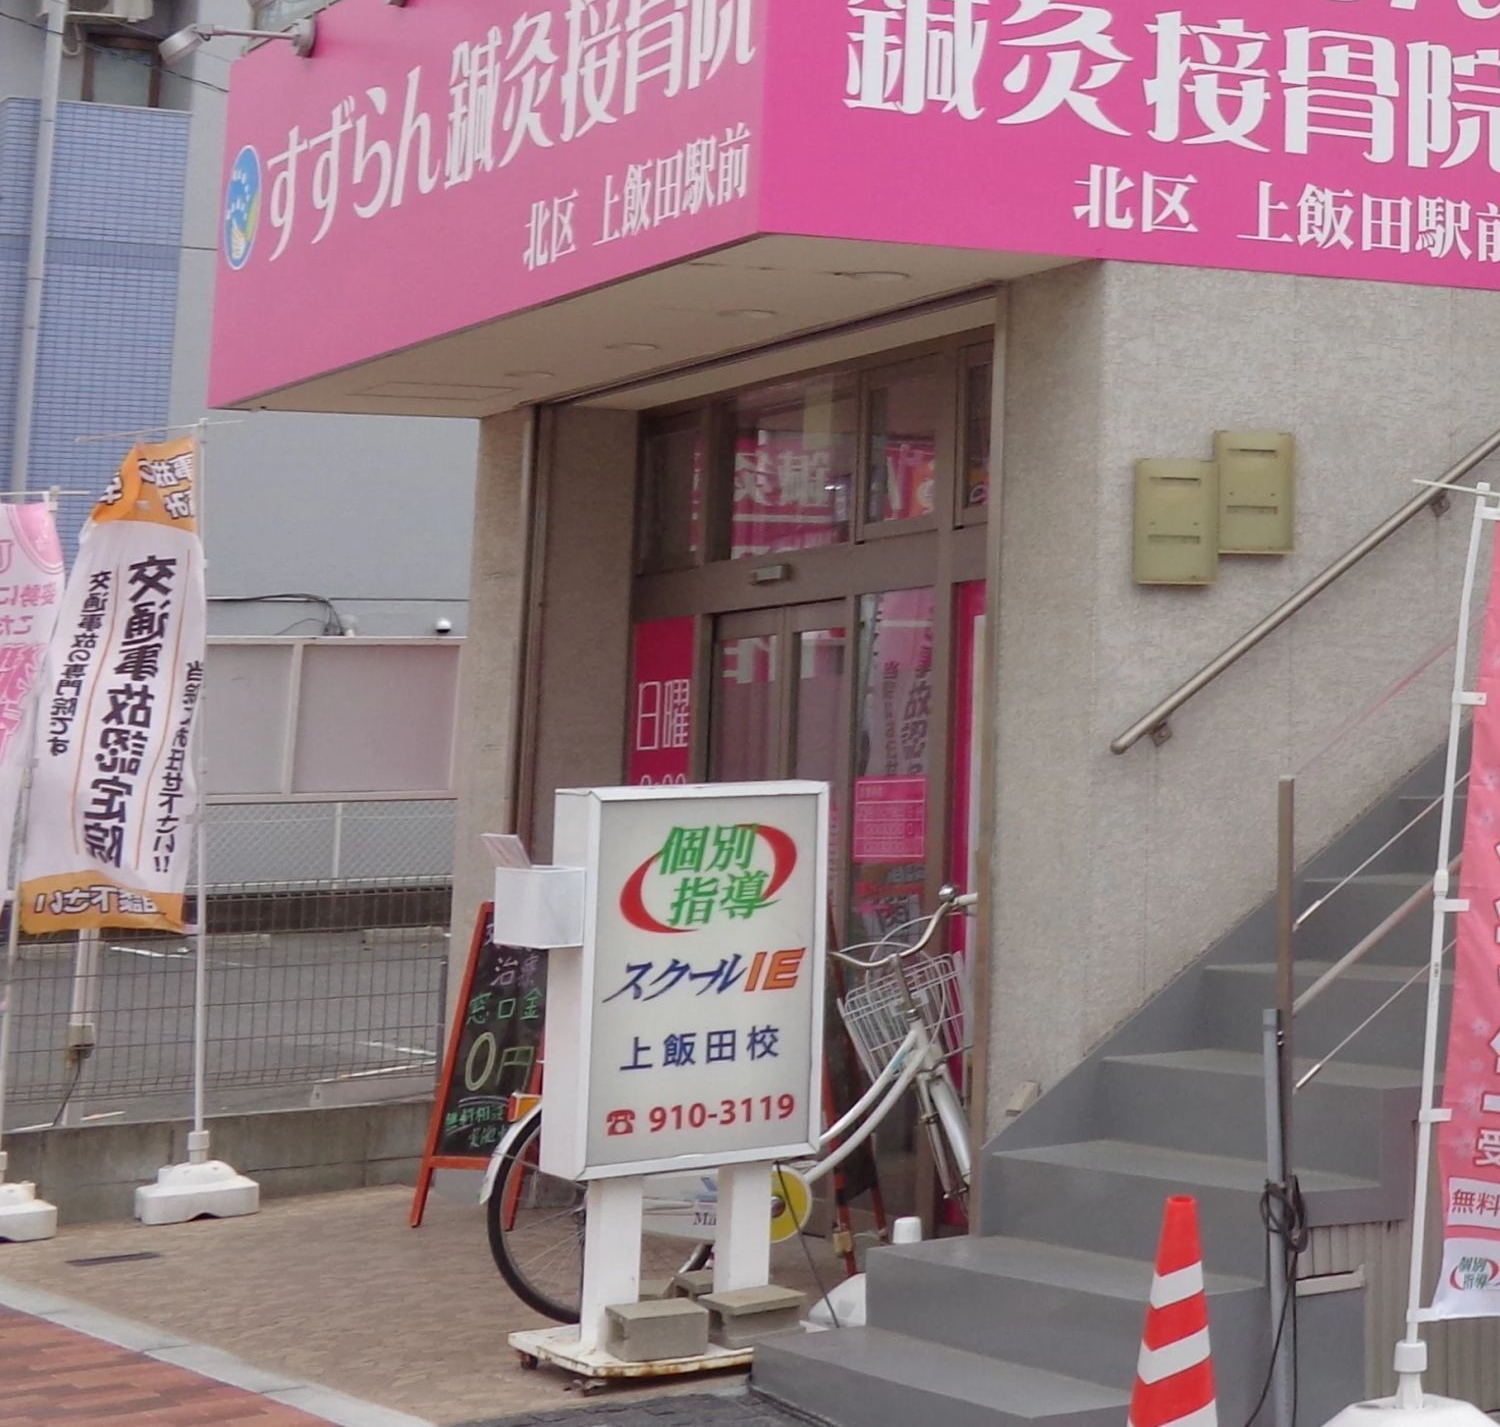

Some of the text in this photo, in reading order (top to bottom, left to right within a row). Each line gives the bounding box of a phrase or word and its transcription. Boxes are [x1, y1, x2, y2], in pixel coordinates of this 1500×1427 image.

[522, 122, 751, 272] 北区 上飯田駅前
[1073, 164, 1200, 236] 北区
[636, 678, 691, 753] 日曜
[658, 823, 759, 875] 個別
[667, 871, 781, 927] 指導
[602, 947, 806, 1003] スクールIE
[619, 1025, 779, 1072] 上飯田校
[649, 1094, 795, 1133] 910-3119
